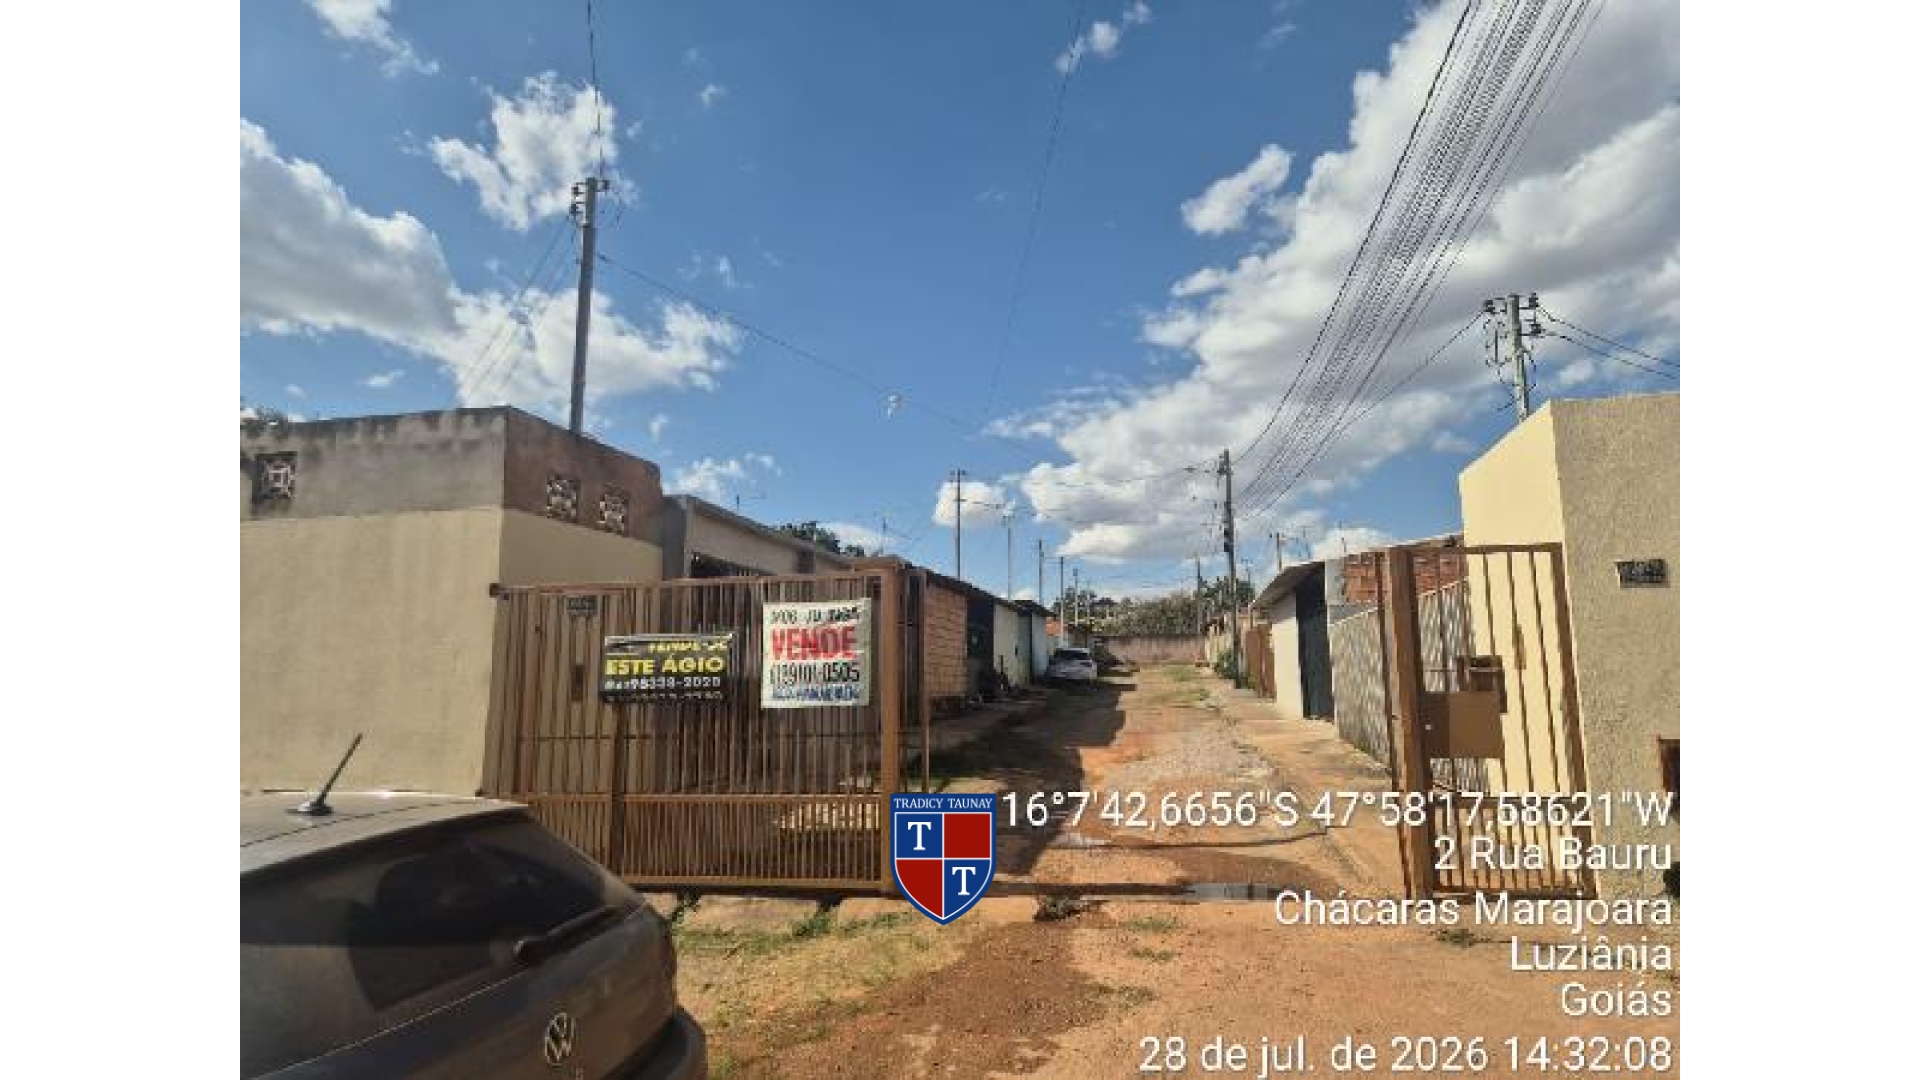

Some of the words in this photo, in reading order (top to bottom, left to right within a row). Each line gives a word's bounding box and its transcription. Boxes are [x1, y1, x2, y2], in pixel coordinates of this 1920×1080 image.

[771, 626, 859, 660] VENDE
[605, 659, 655, 675] ESTE
[661, 653, 724, 673] ÁGIO
